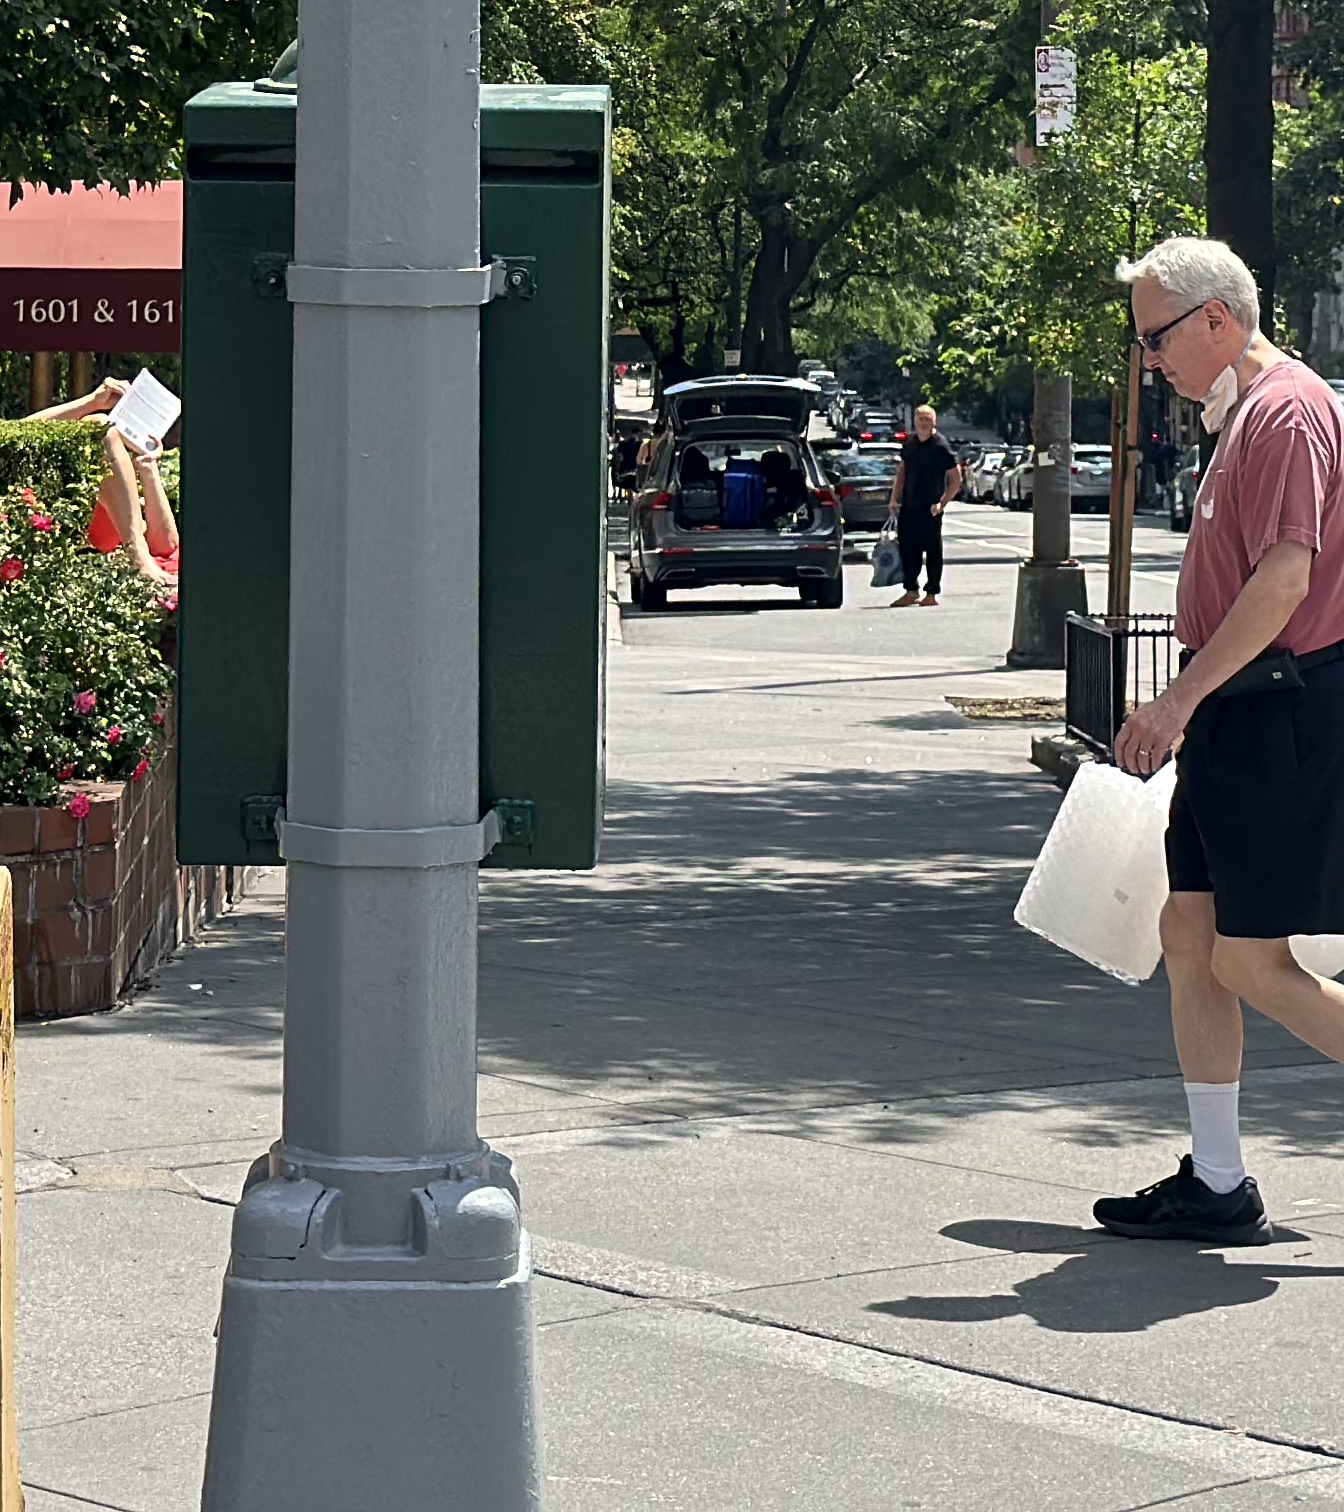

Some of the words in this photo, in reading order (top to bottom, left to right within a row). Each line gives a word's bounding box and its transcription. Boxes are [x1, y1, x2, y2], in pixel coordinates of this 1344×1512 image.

[13, 298, 79, 323] 1601
[93, 298, 115, 323] &
[127, 299, 182, 324] 161
